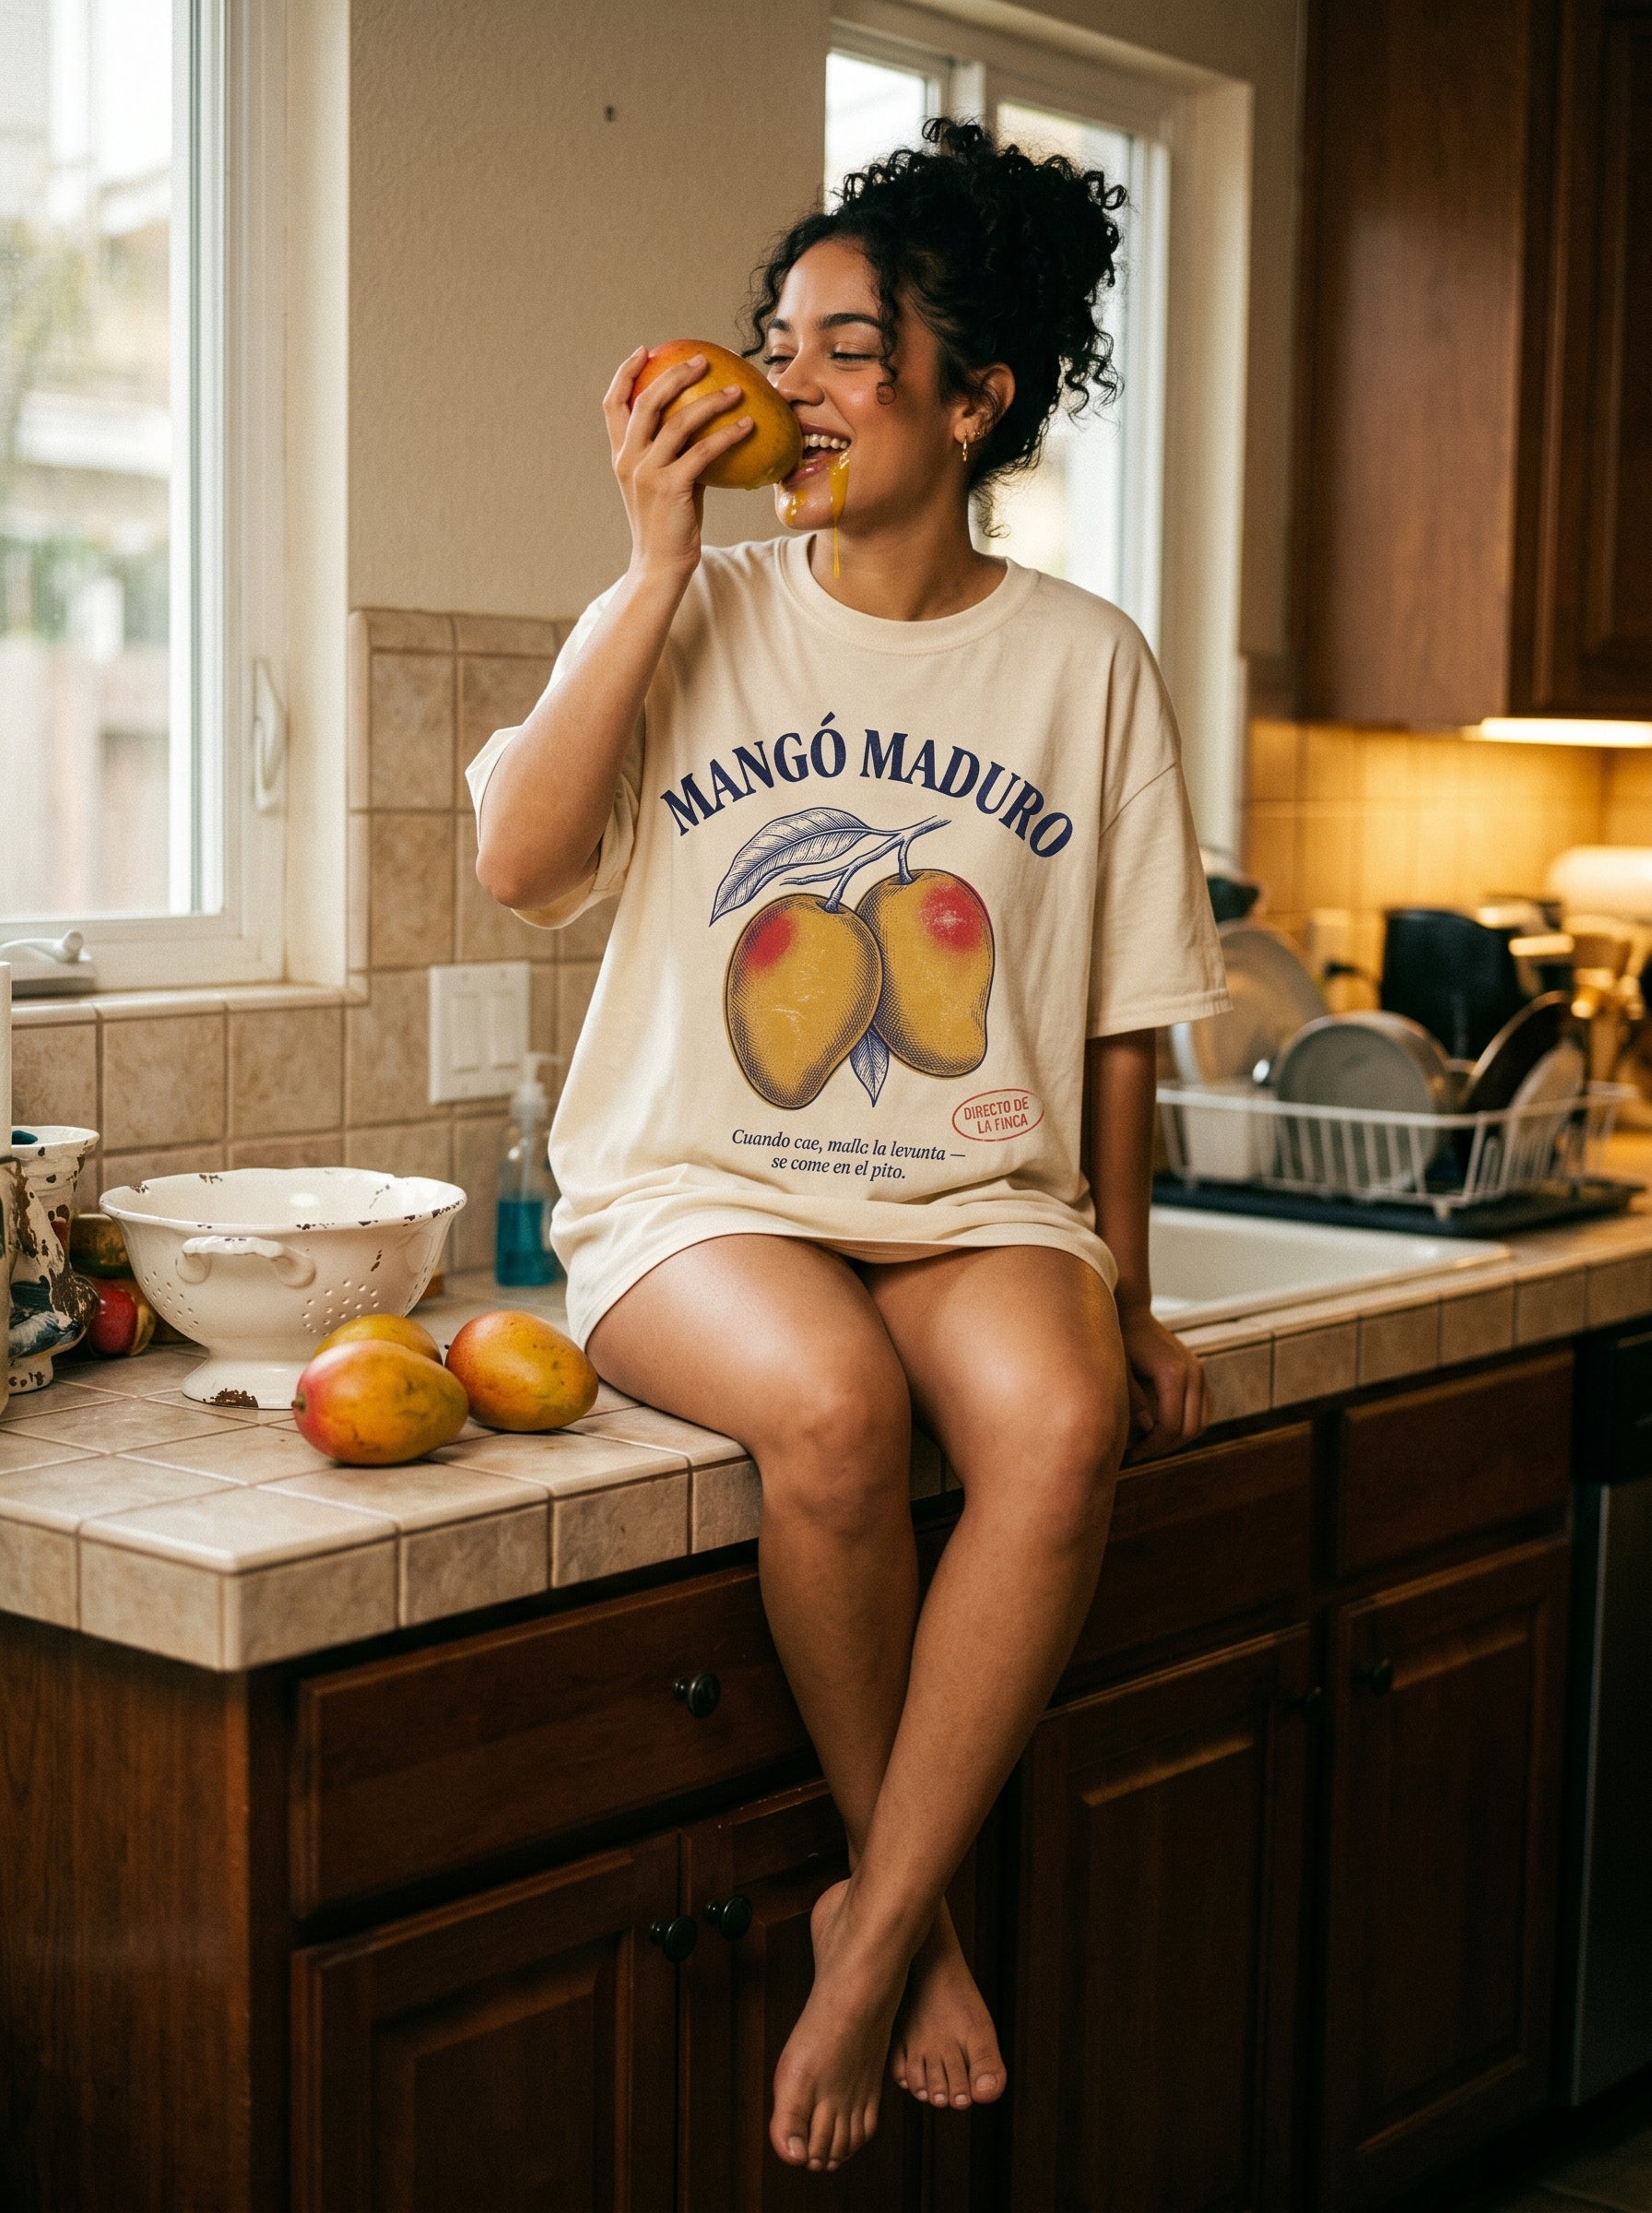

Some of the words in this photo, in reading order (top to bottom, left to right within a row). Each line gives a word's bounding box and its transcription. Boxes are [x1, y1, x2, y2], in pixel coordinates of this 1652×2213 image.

[660, 711, 846, 836] MANGÓ
[859, 728, 1073, 858] MADURO
[963, 1101, 1010, 1120] DIRECTO
[1013, 1096, 1029, 1111] DE
[977, 1120, 992, 1133] LA
[995, 1114, 1028, 1130] FINCA
[732, 1129, 791, 1148] Cuando
[794, 1138, 823, 1154] cae,
[872, 1140, 887, 1156] la
[771, 1157, 788, 1169] se
[790, 1159, 831, 1173] come
[832, 1162, 851, 1175] en
[855, 1160, 869, 1176] el
[869, 1163, 906, 1182] pito.
